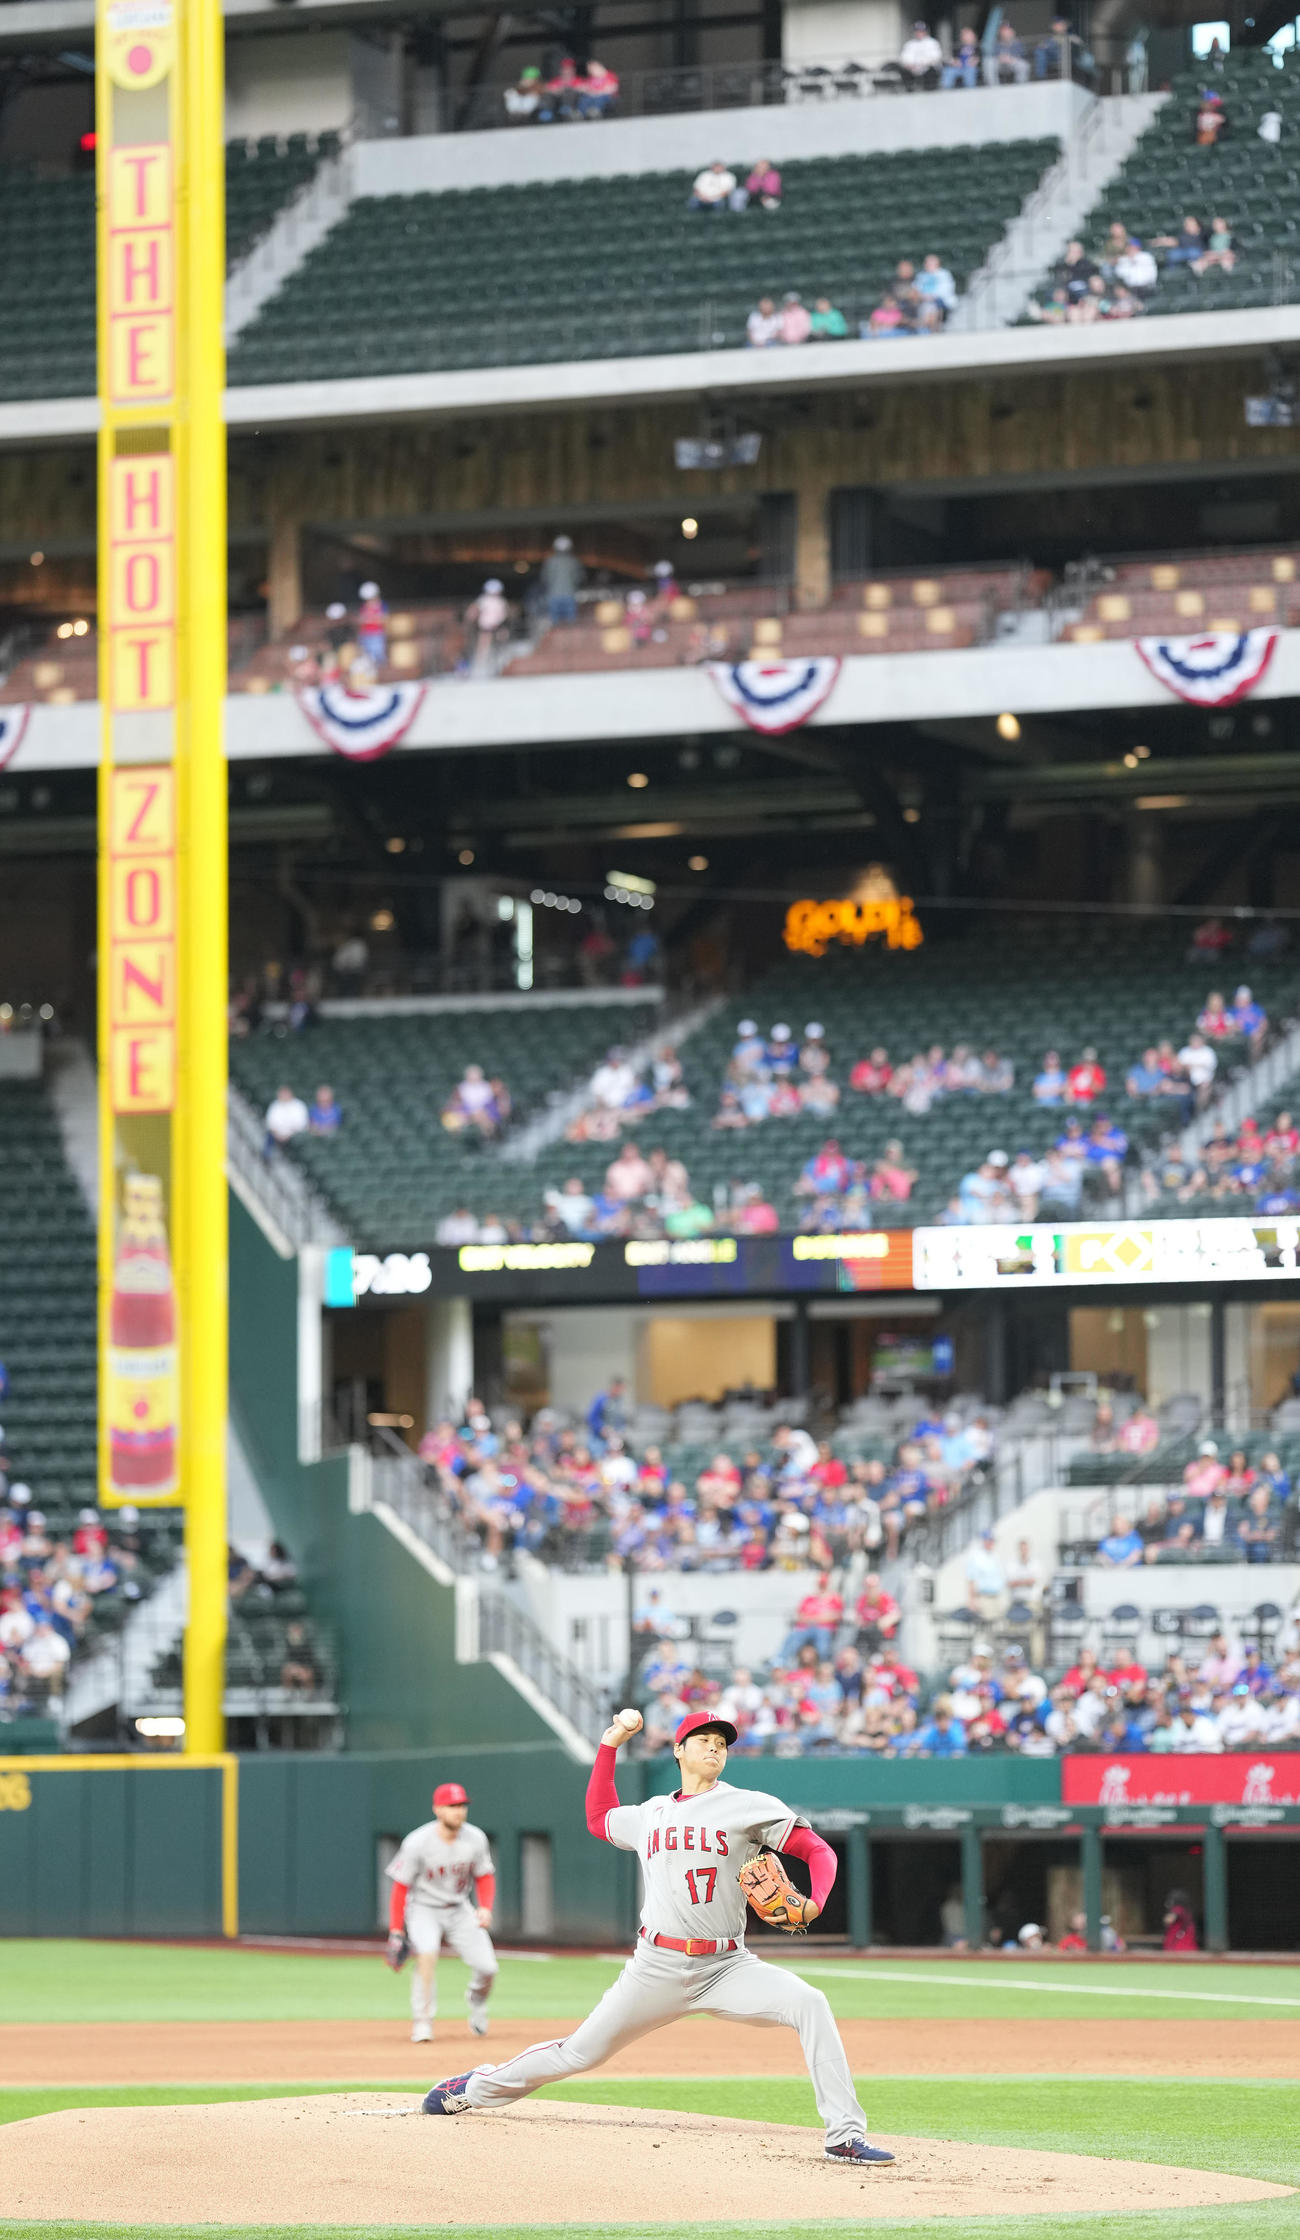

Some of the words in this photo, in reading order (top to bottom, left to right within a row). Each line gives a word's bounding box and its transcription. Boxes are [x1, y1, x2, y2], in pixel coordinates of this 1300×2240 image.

[123, 155, 159, 387] THE
[125, 469, 160, 700] HOT
[122, 784, 165, 1101] ZONE
[685, 1867, 718, 1906] 17
